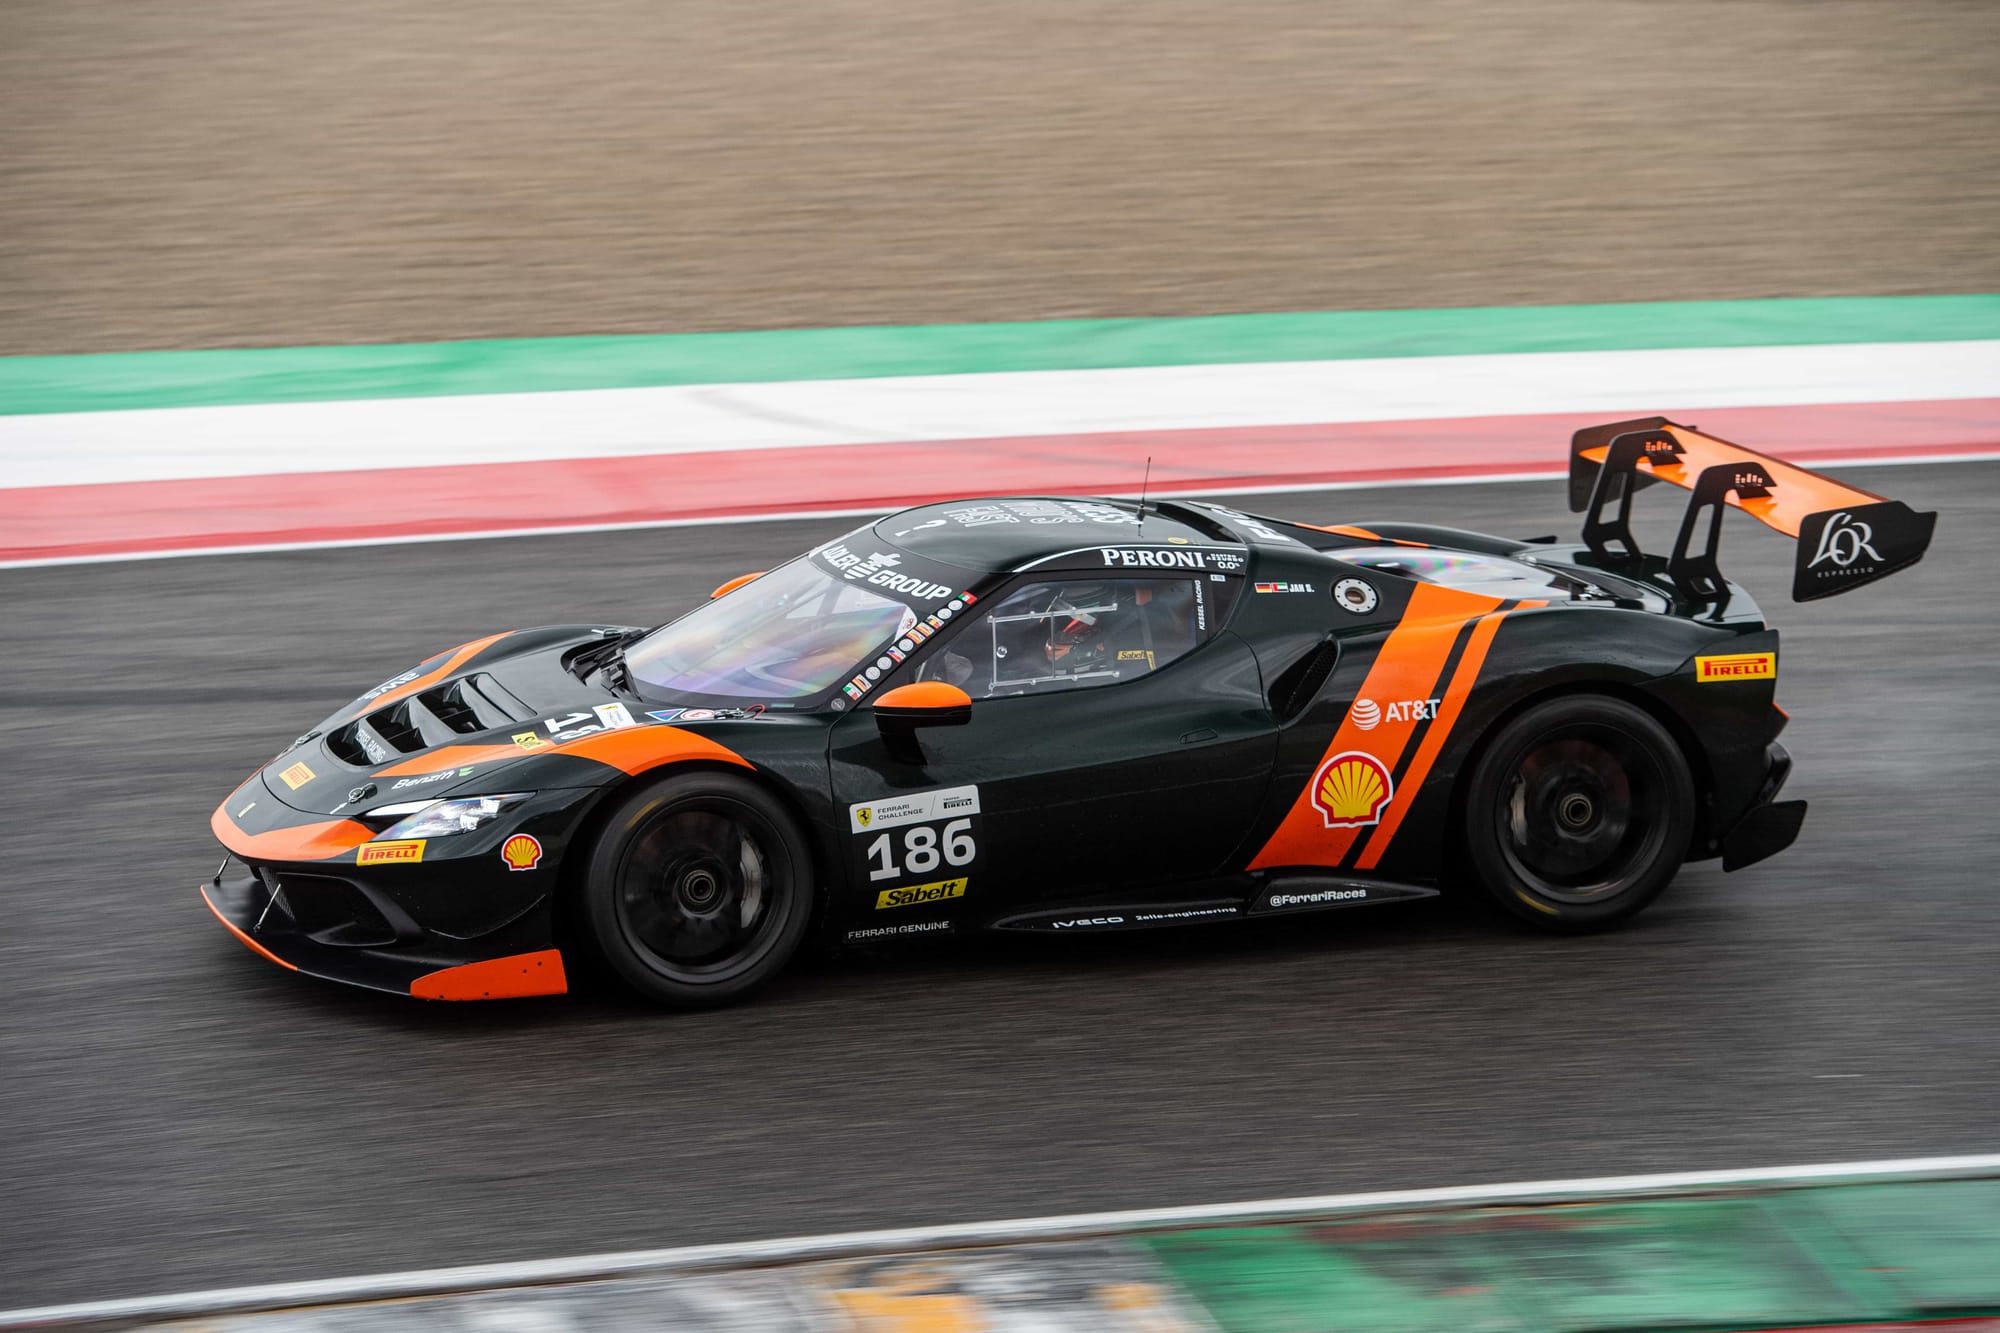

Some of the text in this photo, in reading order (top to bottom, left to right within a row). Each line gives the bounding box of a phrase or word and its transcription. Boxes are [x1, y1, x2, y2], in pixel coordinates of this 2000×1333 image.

[821, 544, 862, 571] ADLER
[1100, 549, 1206, 568] PERONI
[1817, 566, 1874, 579] ESPRESSO
[867, 569, 952, 600] GROUP
[1194, 579, 1206, 631] KESSEL RACING
[1704, 657, 1768, 677] PIRELLI
[1385, 698, 1440, 723] AT&T
[877, 804, 910, 814] FERRARI
[943, 798, 973, 809] PIRELLI
[878, 808, 924, 821] CHALLENGE
[362, 844, 418, 861] PIRELLI
[867, 818, 976, 882] 186
[885, 880, 958, 907] Sabelt
[1269, 888, 1367, 907] @FerrariRaces
[848, 921, 950, 940] FERRARI GENUINE
[1052, 916, 1124, 929] IVECO
